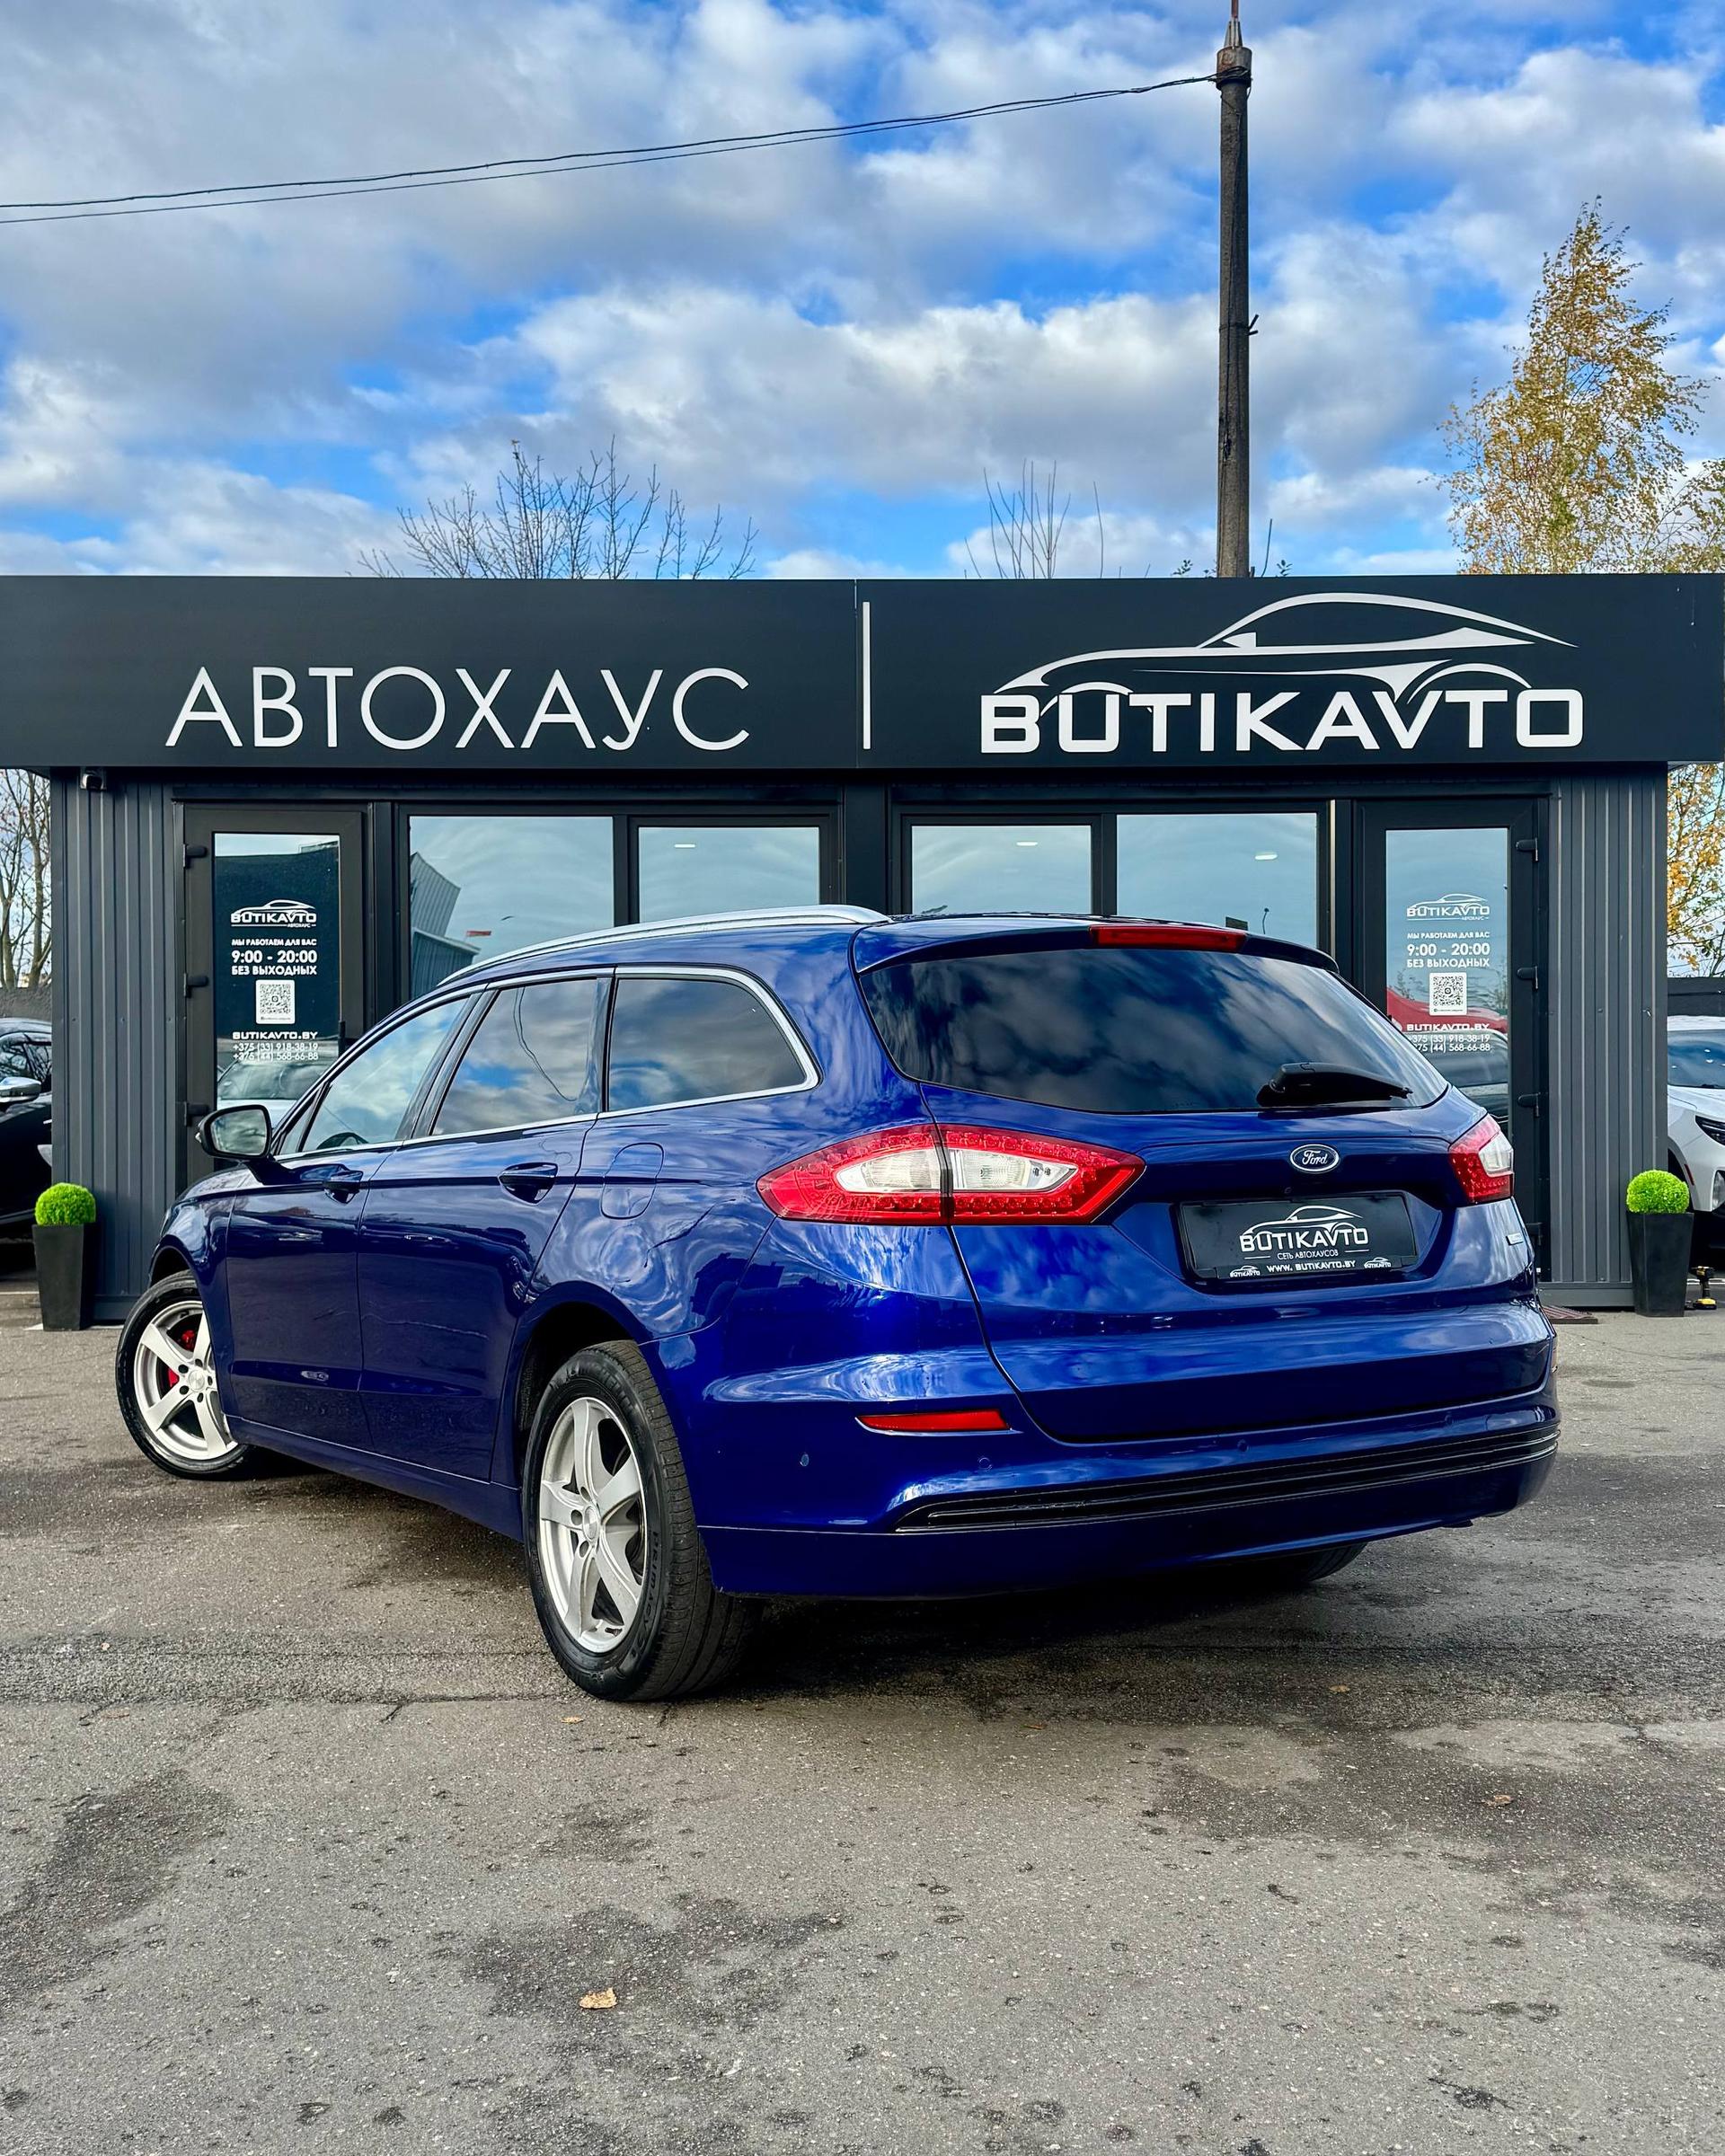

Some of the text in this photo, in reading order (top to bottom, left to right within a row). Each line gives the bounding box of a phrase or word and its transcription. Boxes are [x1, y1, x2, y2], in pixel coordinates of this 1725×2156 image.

[165, 666, 749, 751] АВТОХАУС
[980, 688, 1584, 754] BUTIKAVTO
[1406, 906, 1491, 917] BUTIKAVTO
[231, 912, 317, 923] BUTIKAVTO
[284, 939, 301, 947] ДЛЯ
[1407, 943, 1438, 957] 9:00
[1451, 942, 1491, 956] 20:00
[231, 950, 263, 964] 9:00
[277, 950, 318, 964] 20:00
[1407, 958, 1491, 968] БЕЗ ВЫХОДНЫХ
[231, 965, 317, 976] БЕЗ ВЫХОДНЫХ
[1407, 1023, 1490, 1031] BUTIKAVTO.BY
[233, 1031, 318, 1040] BUTIKAVTO.BY
[1448, 1034, 1491, 1043] 918-38-19
[276, 1042, 318, 1052] 918-38-19
[1430, 1042, 1446, 1054] (44)
[1448, 1043, 1491, 1052] 568-66-88
[1302, 1150, 1328, 1165] Ford
[1239, 1228, 1369, 1252] BUTIKAVTO
[1277, 1249, 1339, 1260] СЕТЬ АВТОХАУСОВ
